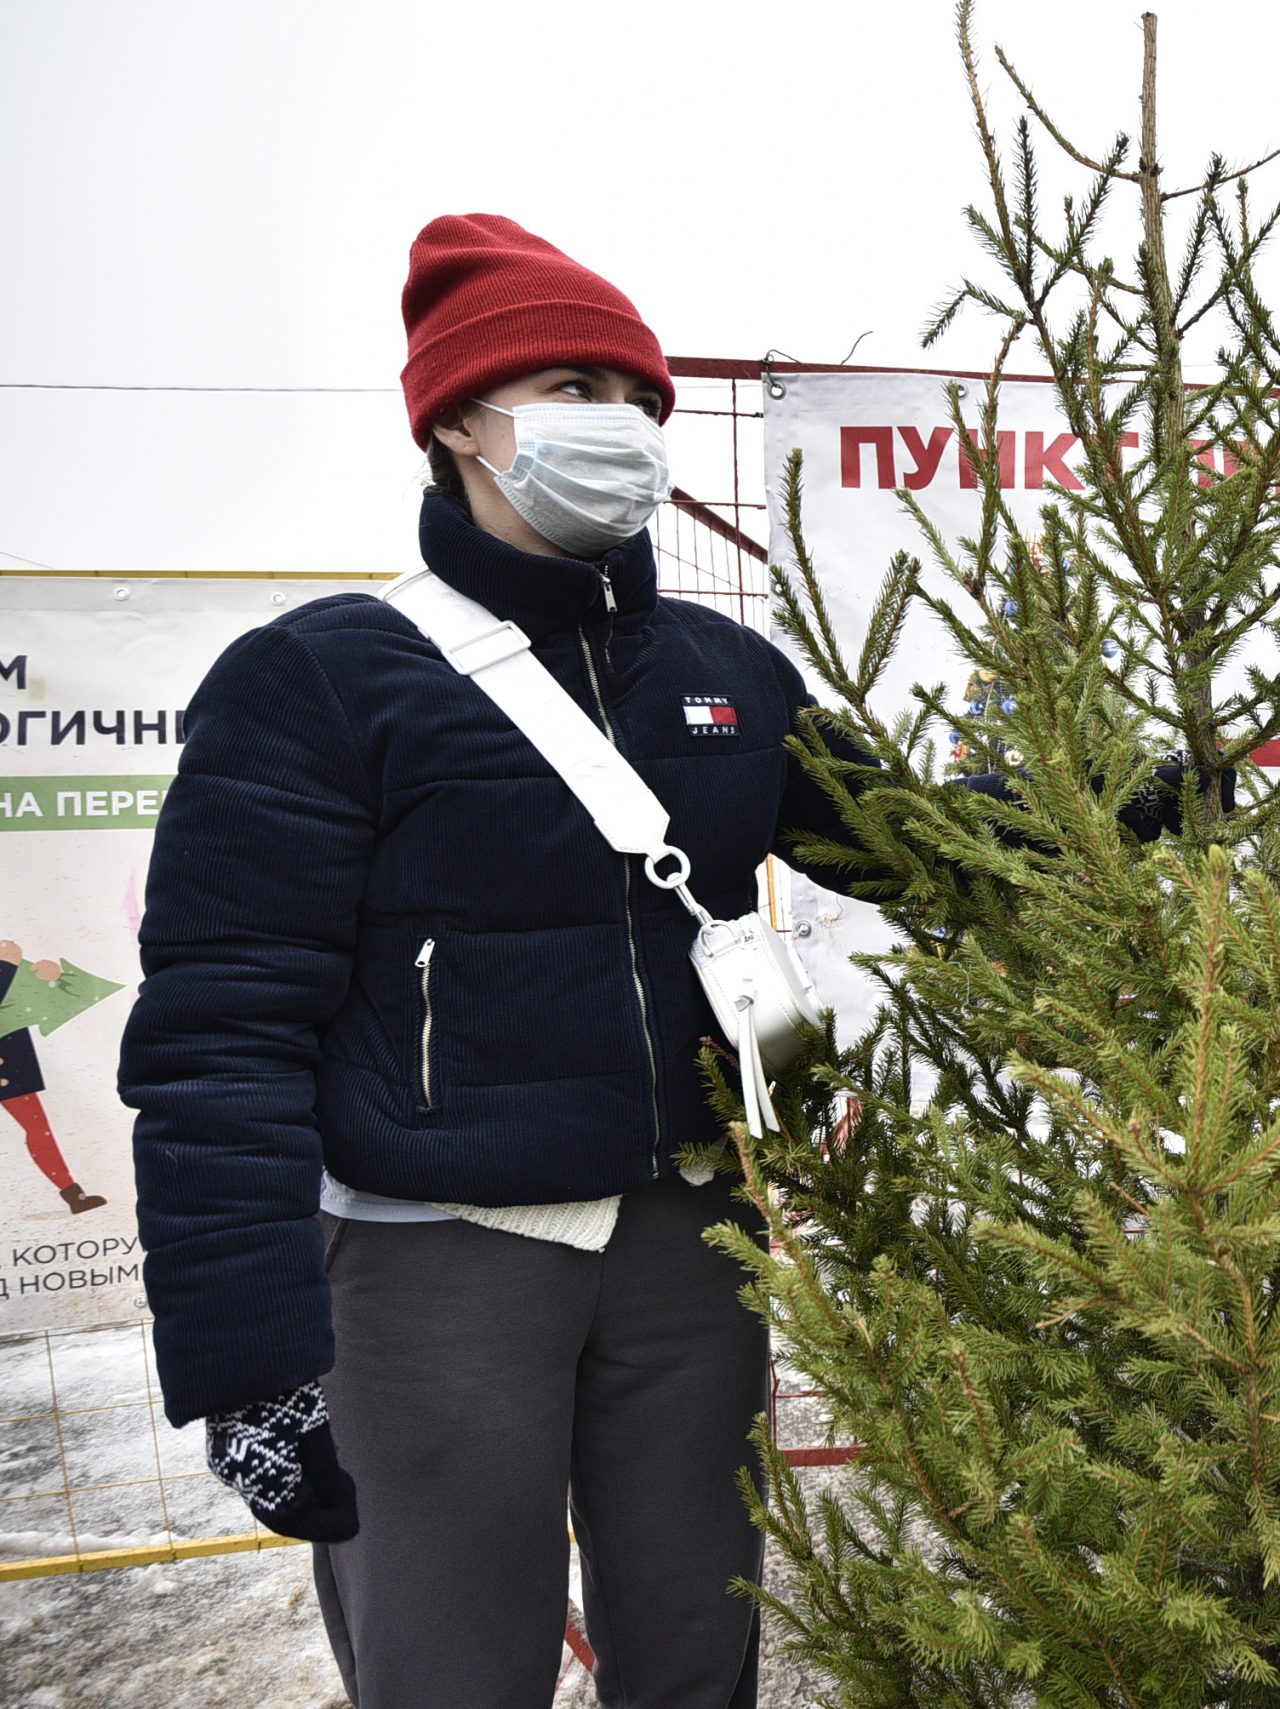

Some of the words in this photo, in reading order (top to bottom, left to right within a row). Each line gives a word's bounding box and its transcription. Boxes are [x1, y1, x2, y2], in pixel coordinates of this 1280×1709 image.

[684, 696, 728, 704] TOMMY
[692, 726, 735, 734] JEANS
[57, 790, 168, 817] ПЕРЕ
[13, 1236, 138, 1267] КОТОРУ
[20, 1264, 139, 1295] НОВЫМ
